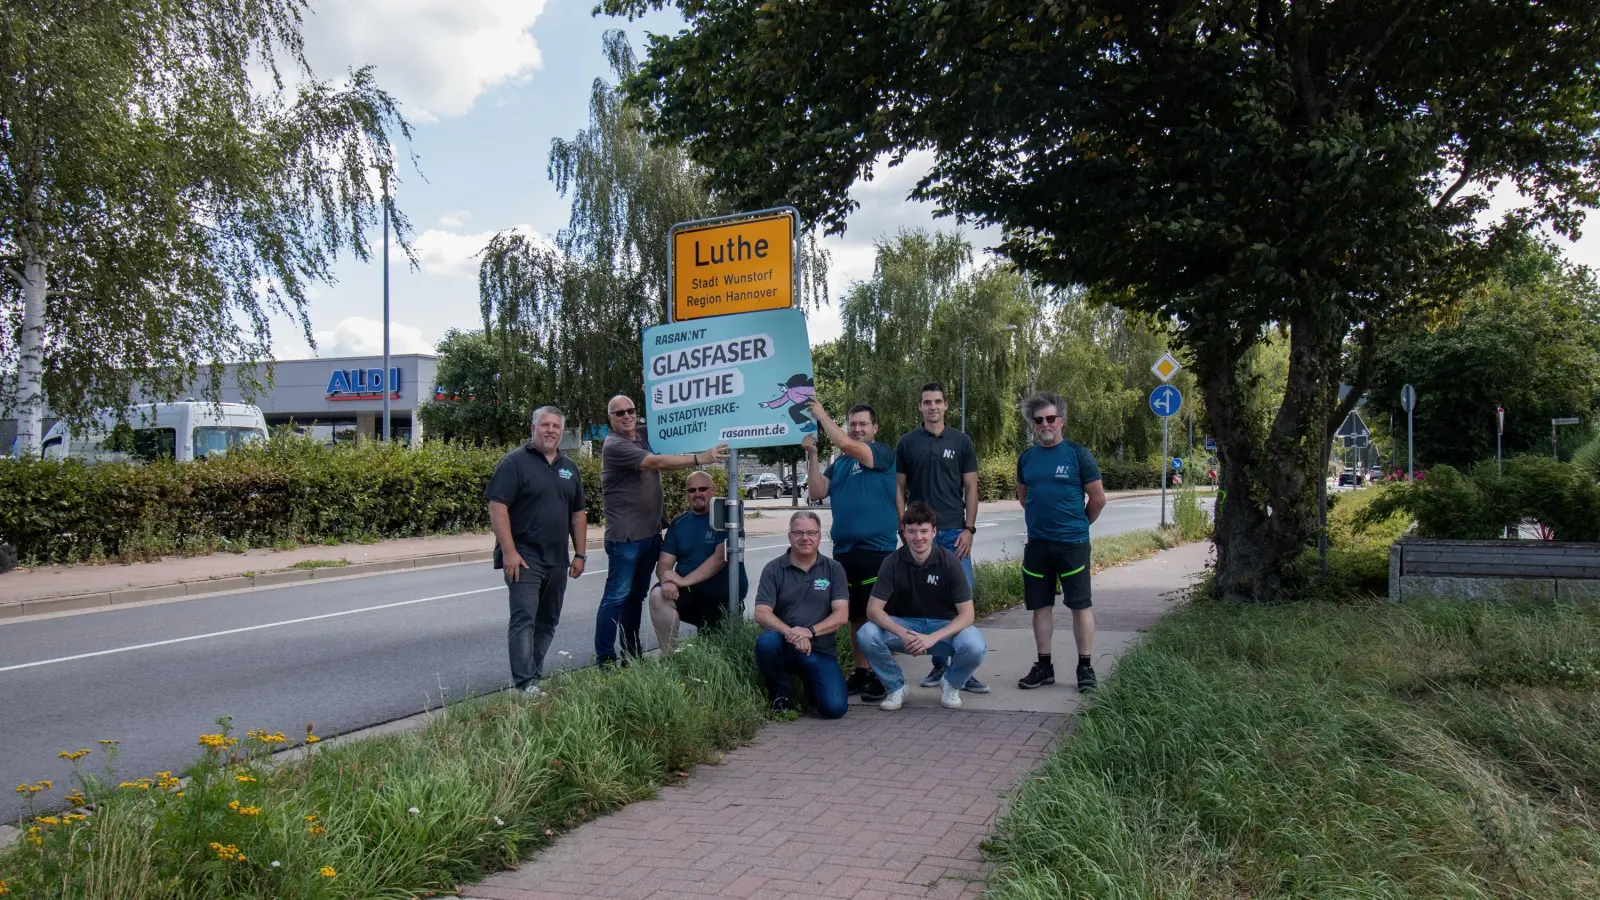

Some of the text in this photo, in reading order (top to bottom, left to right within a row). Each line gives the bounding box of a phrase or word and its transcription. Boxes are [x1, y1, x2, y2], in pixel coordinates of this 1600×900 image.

[695, 235, 768, 267] Luthe
[692, 269, 773, 290] Stadt Wunstorf
[687, 287, 778, 308] Region Hannover
[653, 338, 767, 376] GLASFASER
[326, 367, 400, 393] ALDI
[654, 373, 733, 404] für LUTHE
[657, 402, 740, 425] IN STADTWERKE-
[659, 422, 707, 440] QUALITÄT!
[721, 424, 785, 439] rasannnt.de
